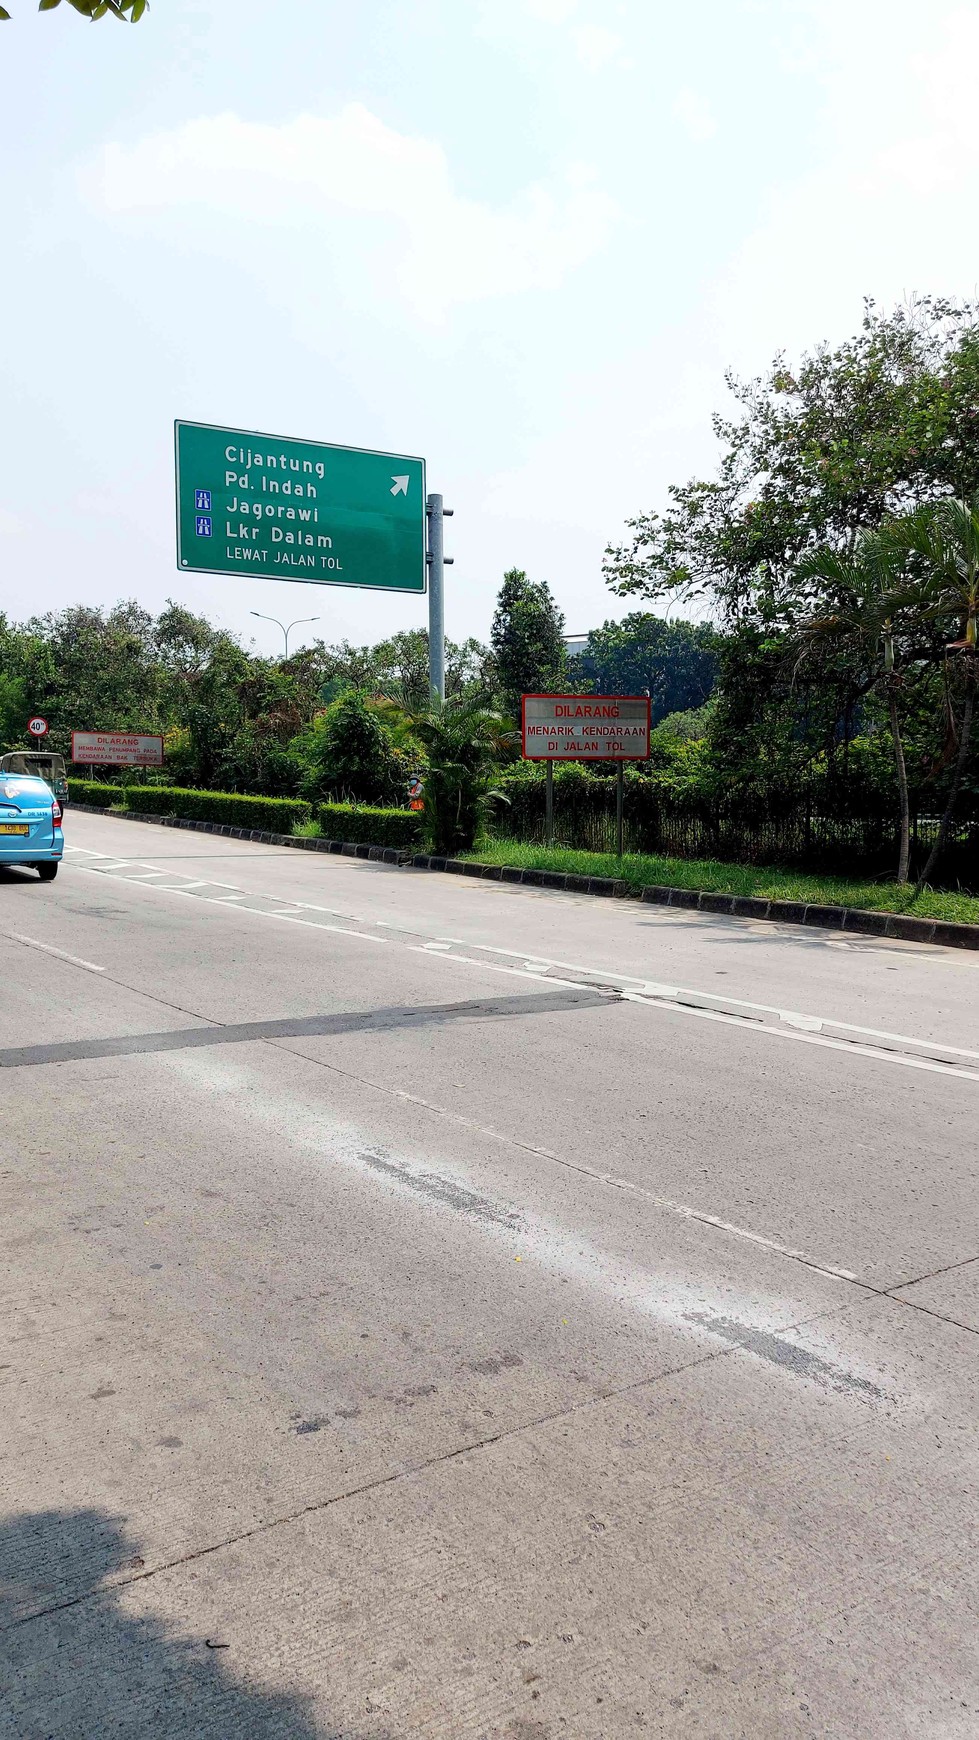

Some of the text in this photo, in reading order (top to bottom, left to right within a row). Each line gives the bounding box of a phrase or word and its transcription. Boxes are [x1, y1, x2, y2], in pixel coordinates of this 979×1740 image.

[225, 446, 325, 479] Cijantung
[225, 471, 317, 498] Pd. Indah
[226, 497, 319, 522] Jagorawi
[226, 521, 332, 549] Lkr Dalam
[226, 547, 343, 570] LEWAT JALAN TOL
[555, 705, 620, 718] DILARANG
[97, 737, 139, 746] DILARANG
[527, 726, 646, 736] MENARIK KENDARAAN
[548, 741, 625, 751] DI JALAN TOL
